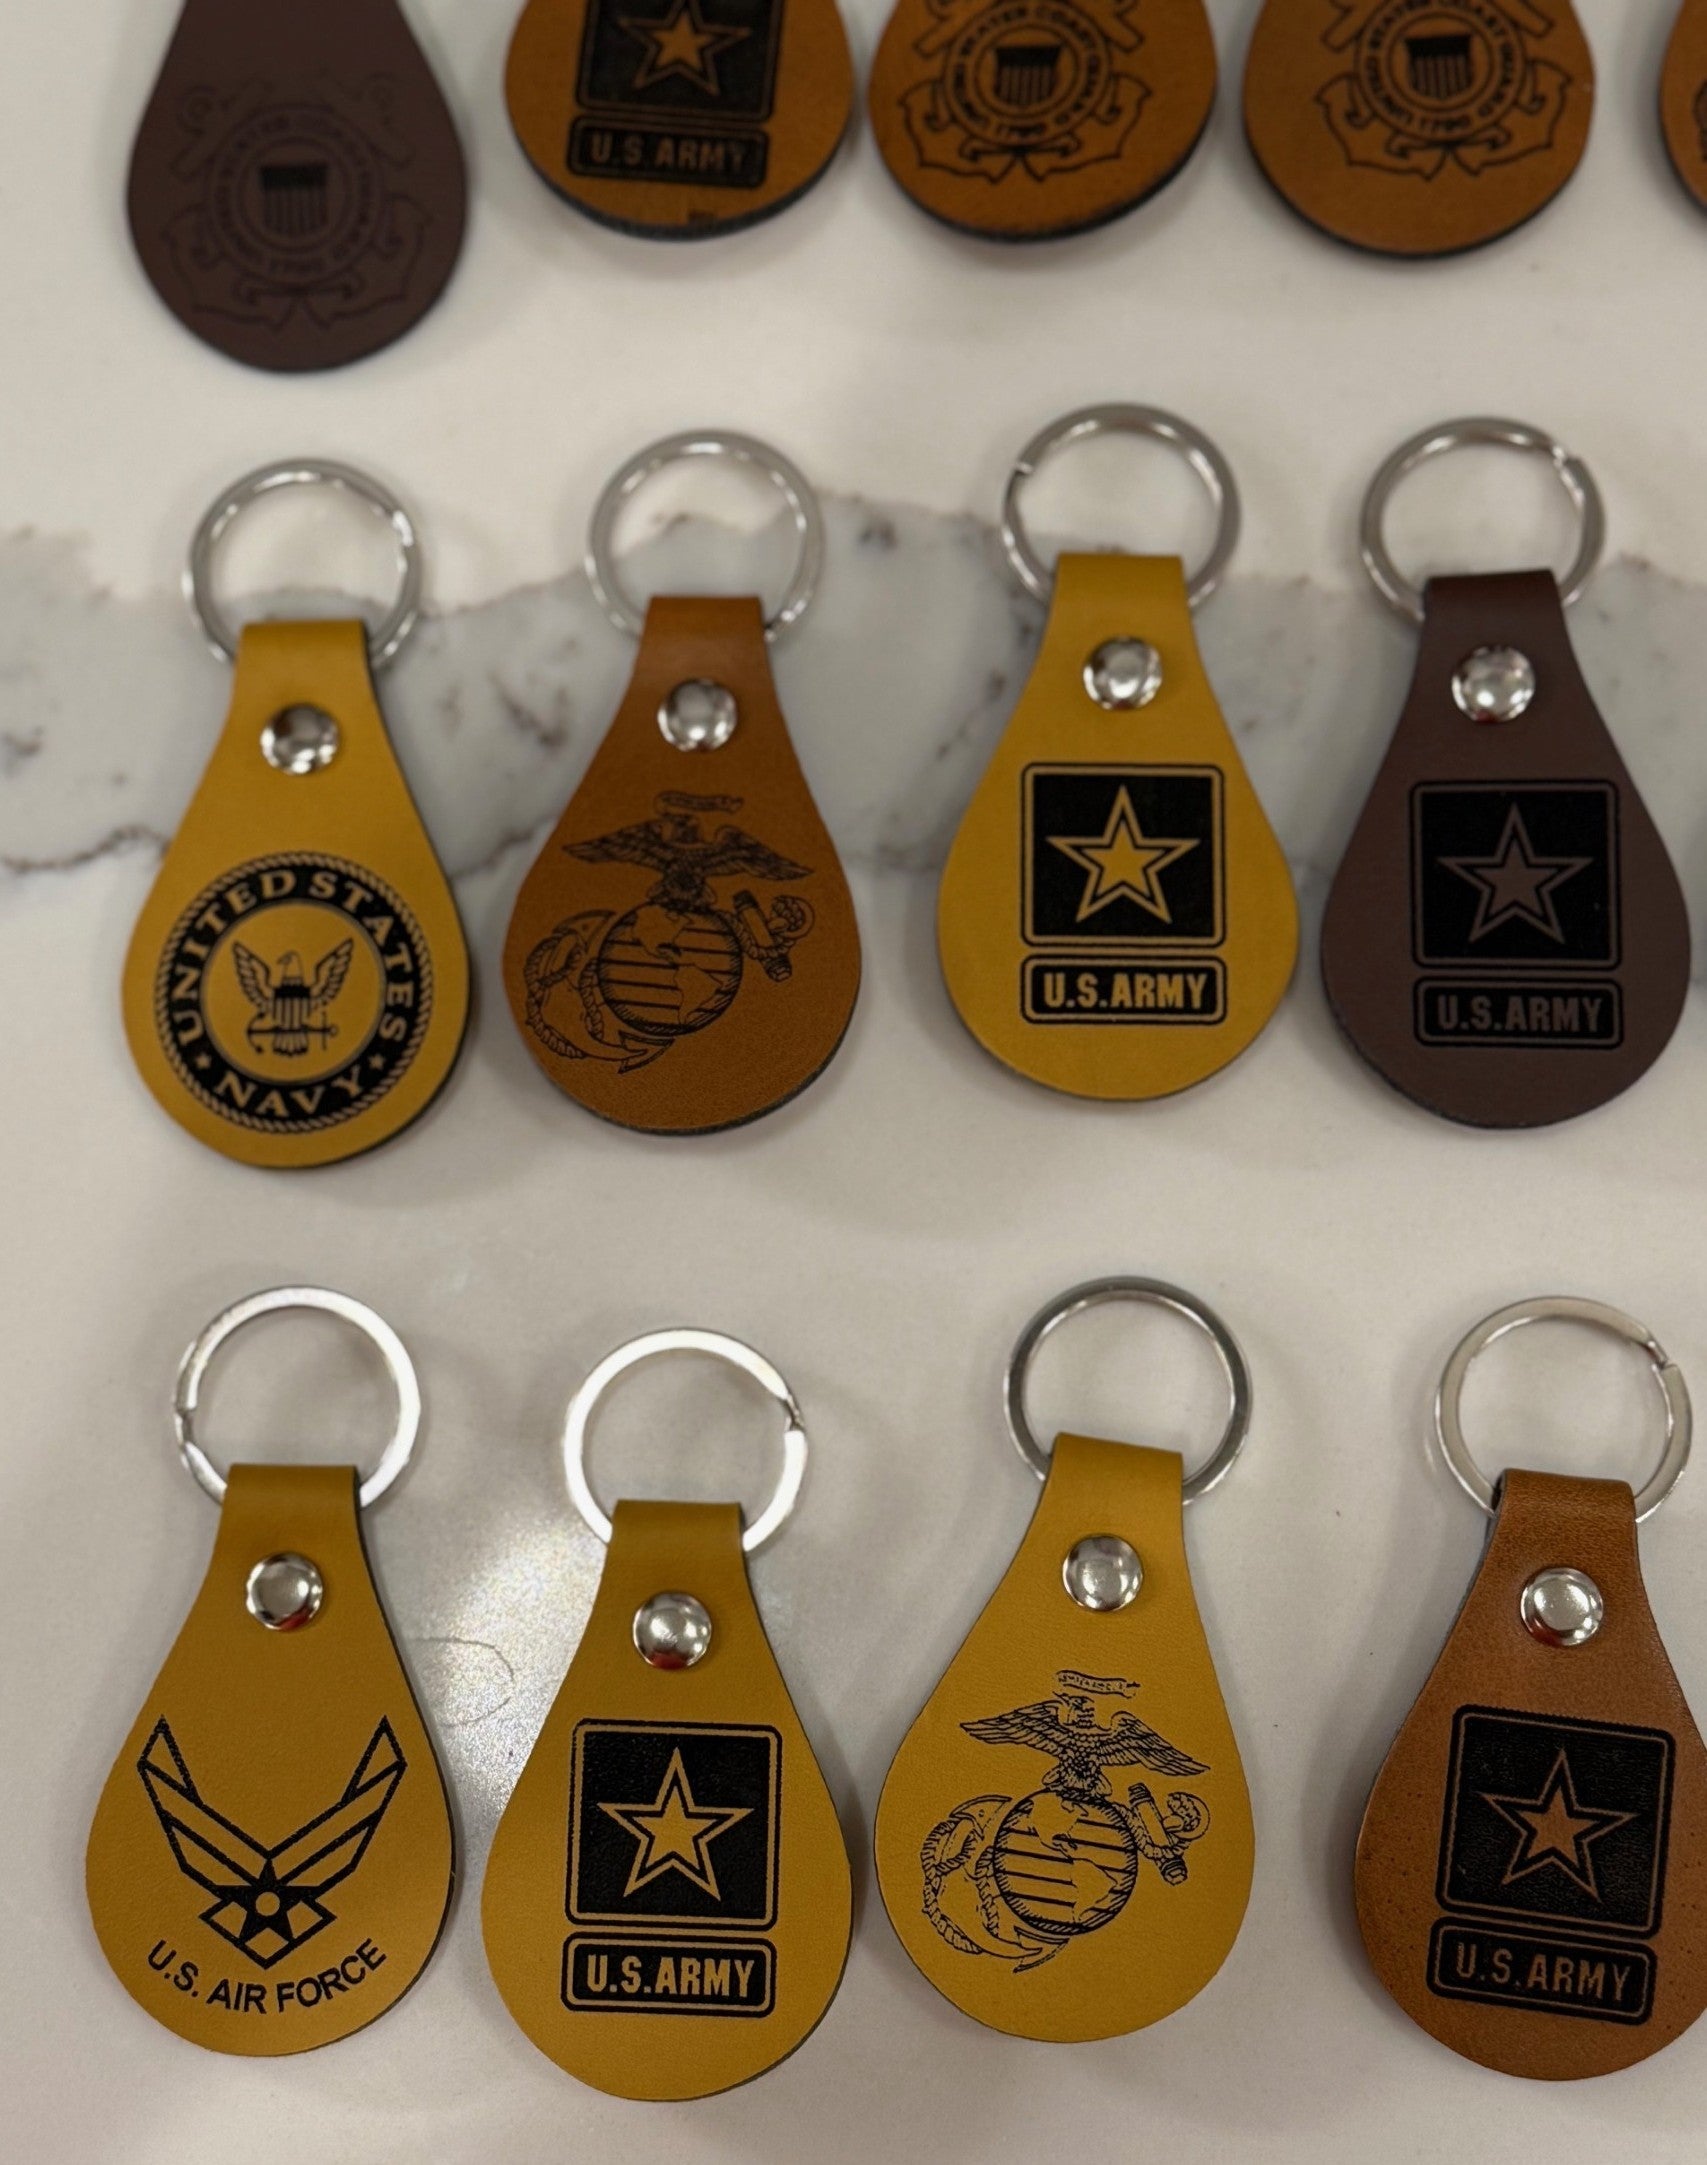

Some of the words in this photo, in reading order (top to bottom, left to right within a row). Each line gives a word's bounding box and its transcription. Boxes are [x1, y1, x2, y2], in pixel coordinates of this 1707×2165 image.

[171, 869, 297, 1045] UNITED
[308, 871, 413, 1041] STATES
[214, 1065, 363, 1117] NAVY
[148, 1939, 199, 1998] U.S.
[206, 1978, 267, 2014] AIR
[276, 1938, 387, 2014] FORCE
